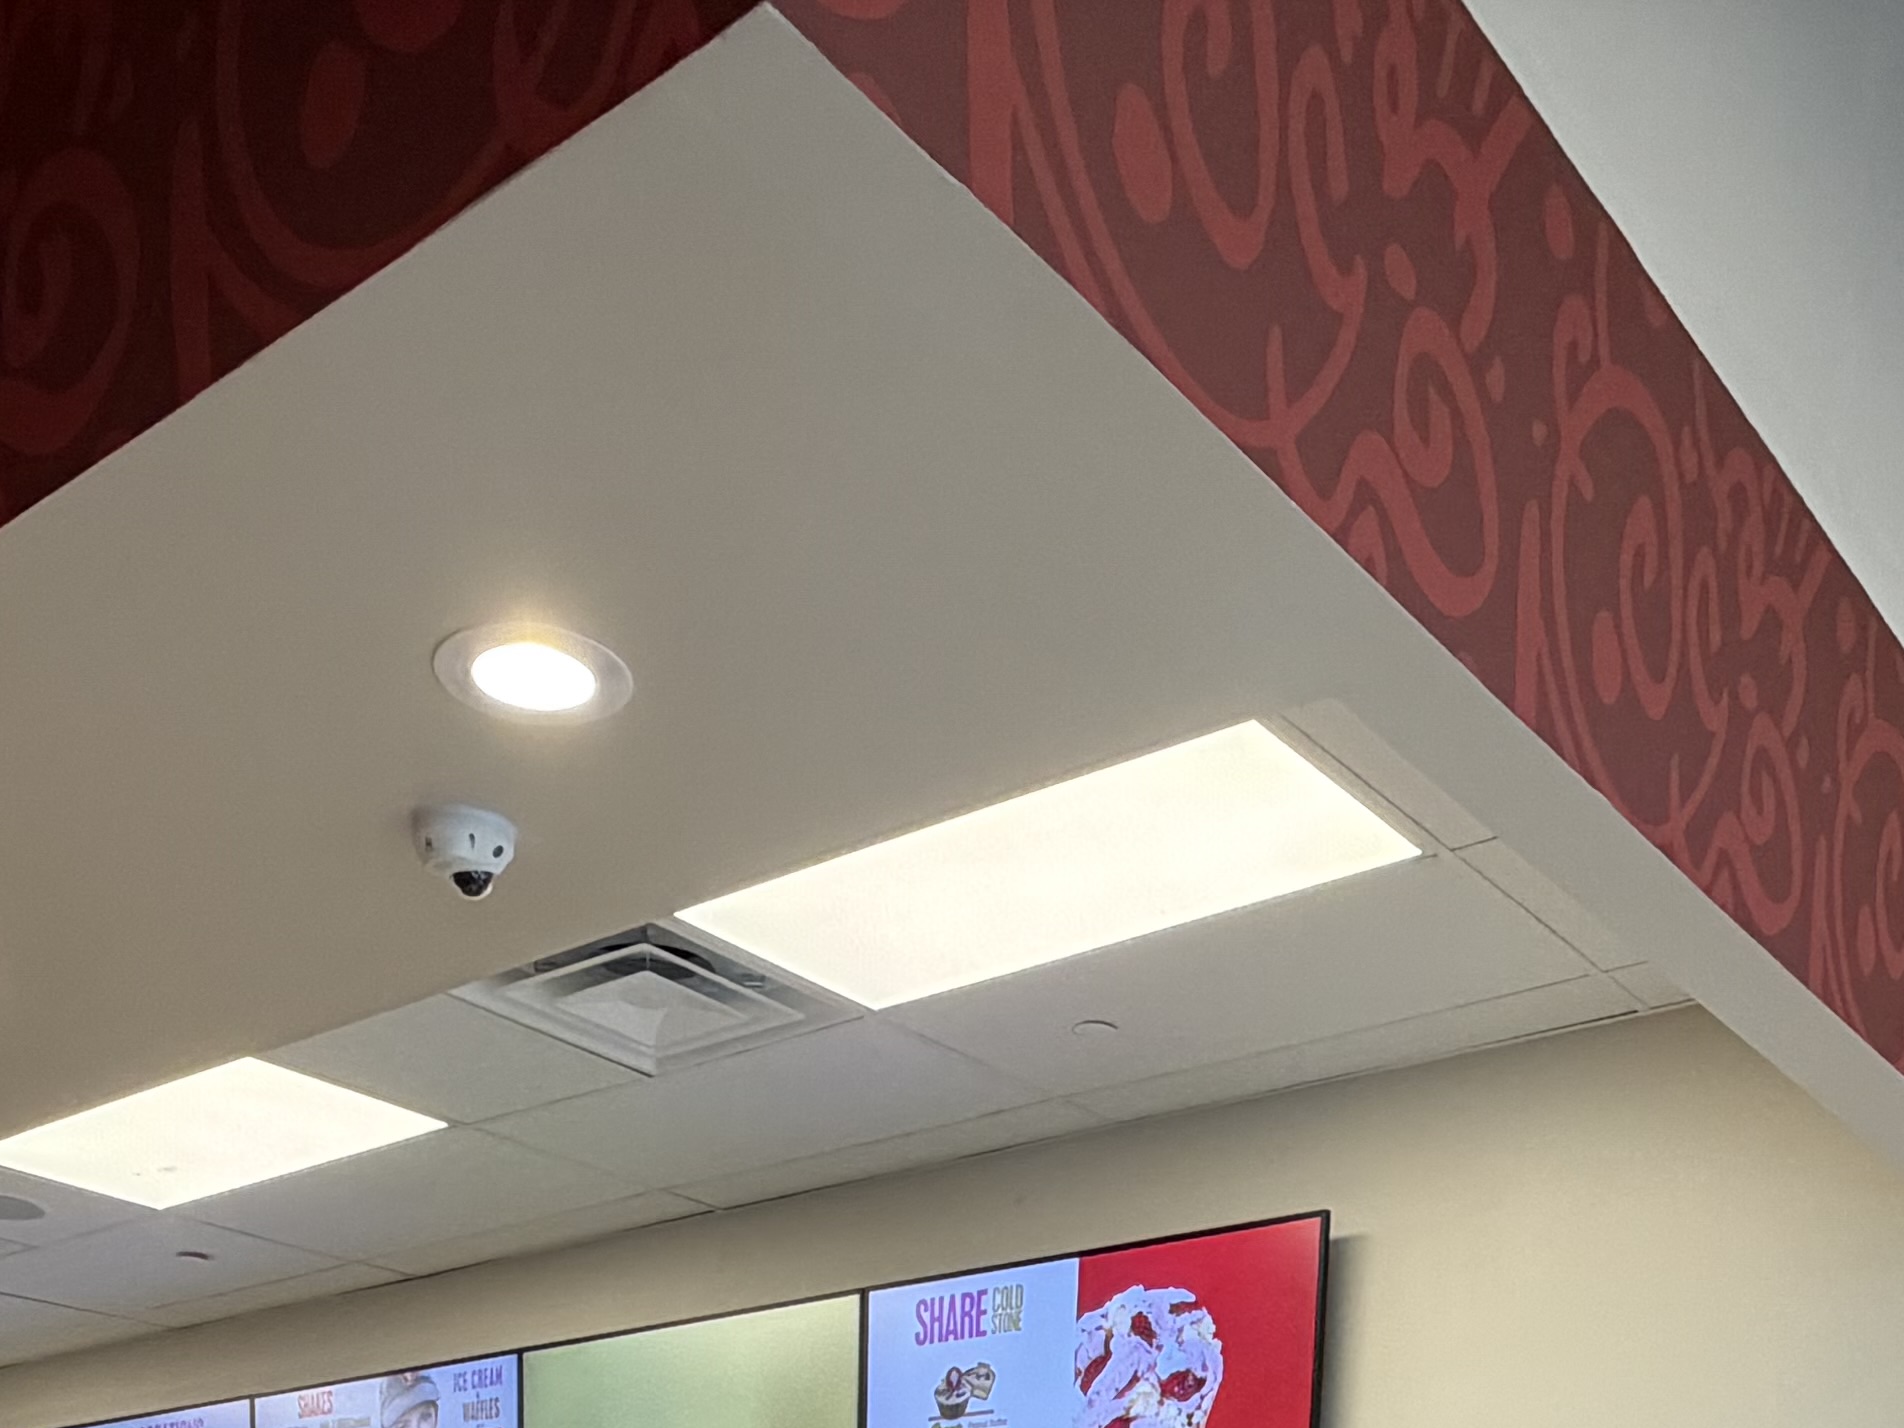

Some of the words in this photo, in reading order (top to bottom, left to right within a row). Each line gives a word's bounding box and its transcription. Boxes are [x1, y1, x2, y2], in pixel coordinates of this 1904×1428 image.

[992, 1284, 1024, 1313] COLD
[915, 1288, 988, 1346] SHARE
[990, 1310, 1022, 1335] STONE
[471, 1365, 503, 1390] CREAM
